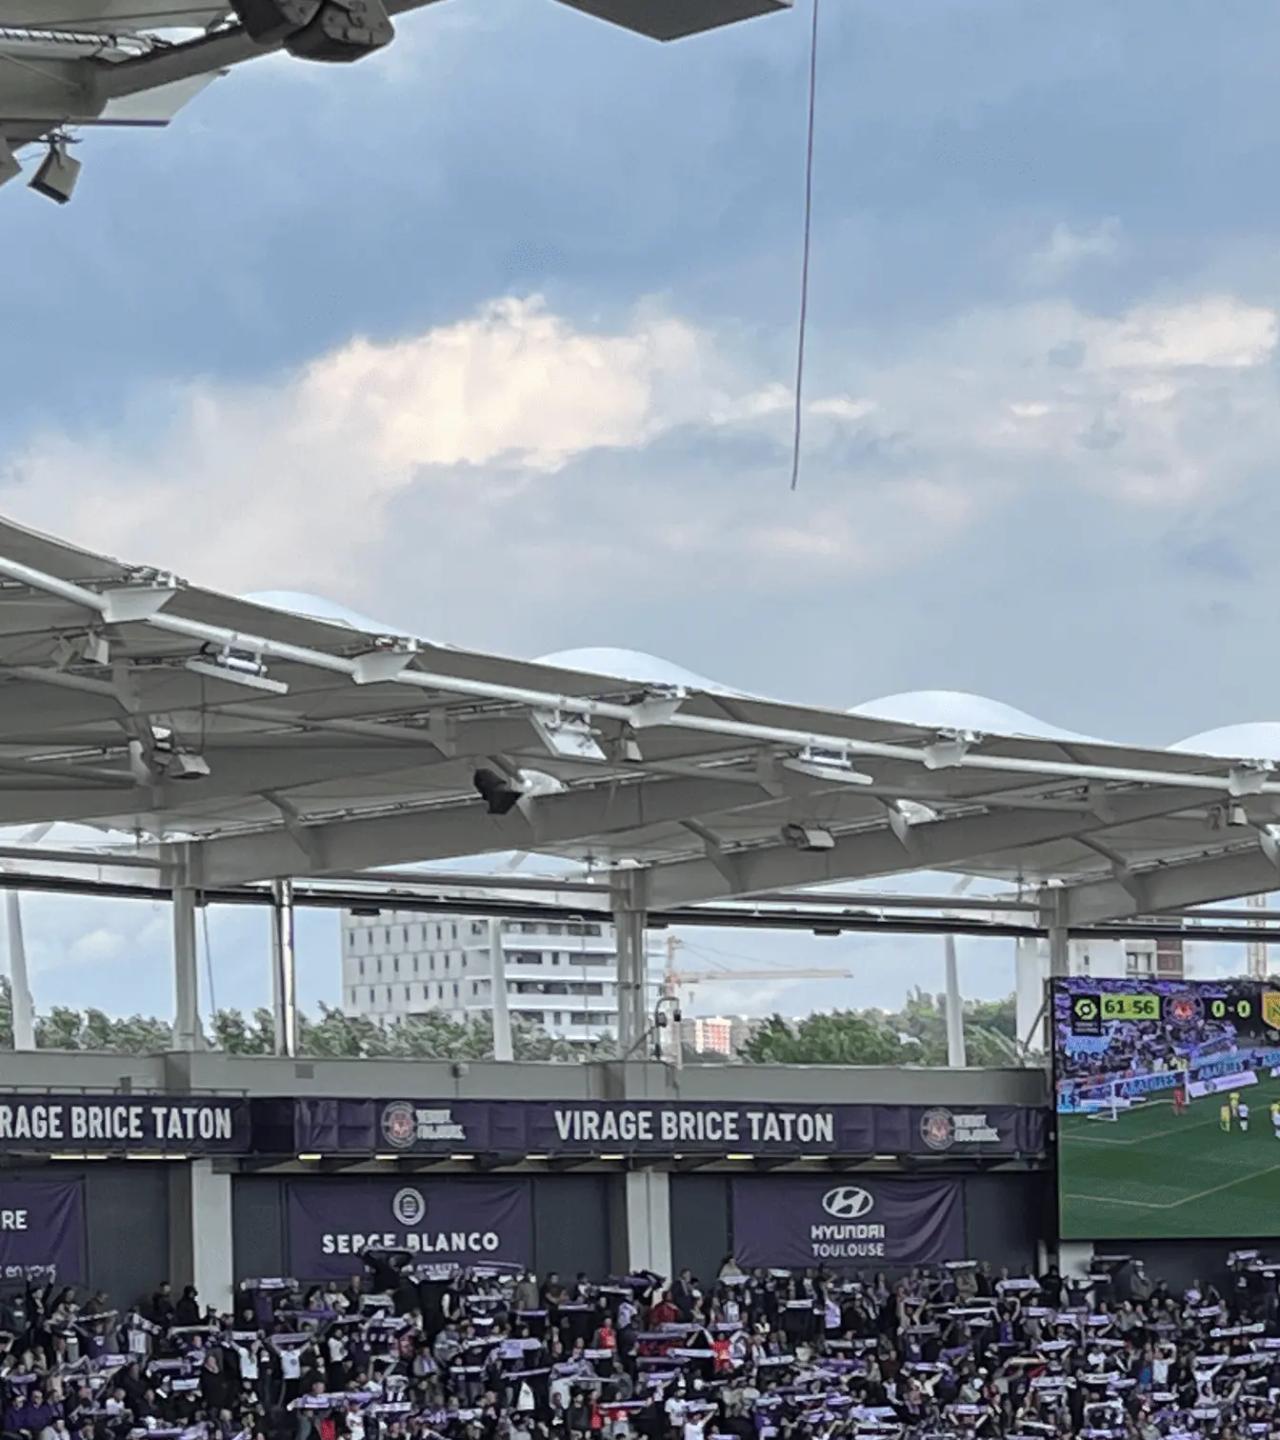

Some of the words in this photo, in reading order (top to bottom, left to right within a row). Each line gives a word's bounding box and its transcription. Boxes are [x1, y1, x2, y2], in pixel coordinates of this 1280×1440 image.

[71, 1105, 143, 1139] BRICE
[151, 1106, 232, 1140] TATON
[555, 1110, 653, 1141] VIRAGE
[660, 1110, 739, 1142] BRICE
[746, 1111, 833, 1143] TATON
[810, 1223, 886, 1240] HYUNDAI
[406, 1232, 500, 1253] BLANCO
[811, 1243, 886, 1259] TOULOUSE
